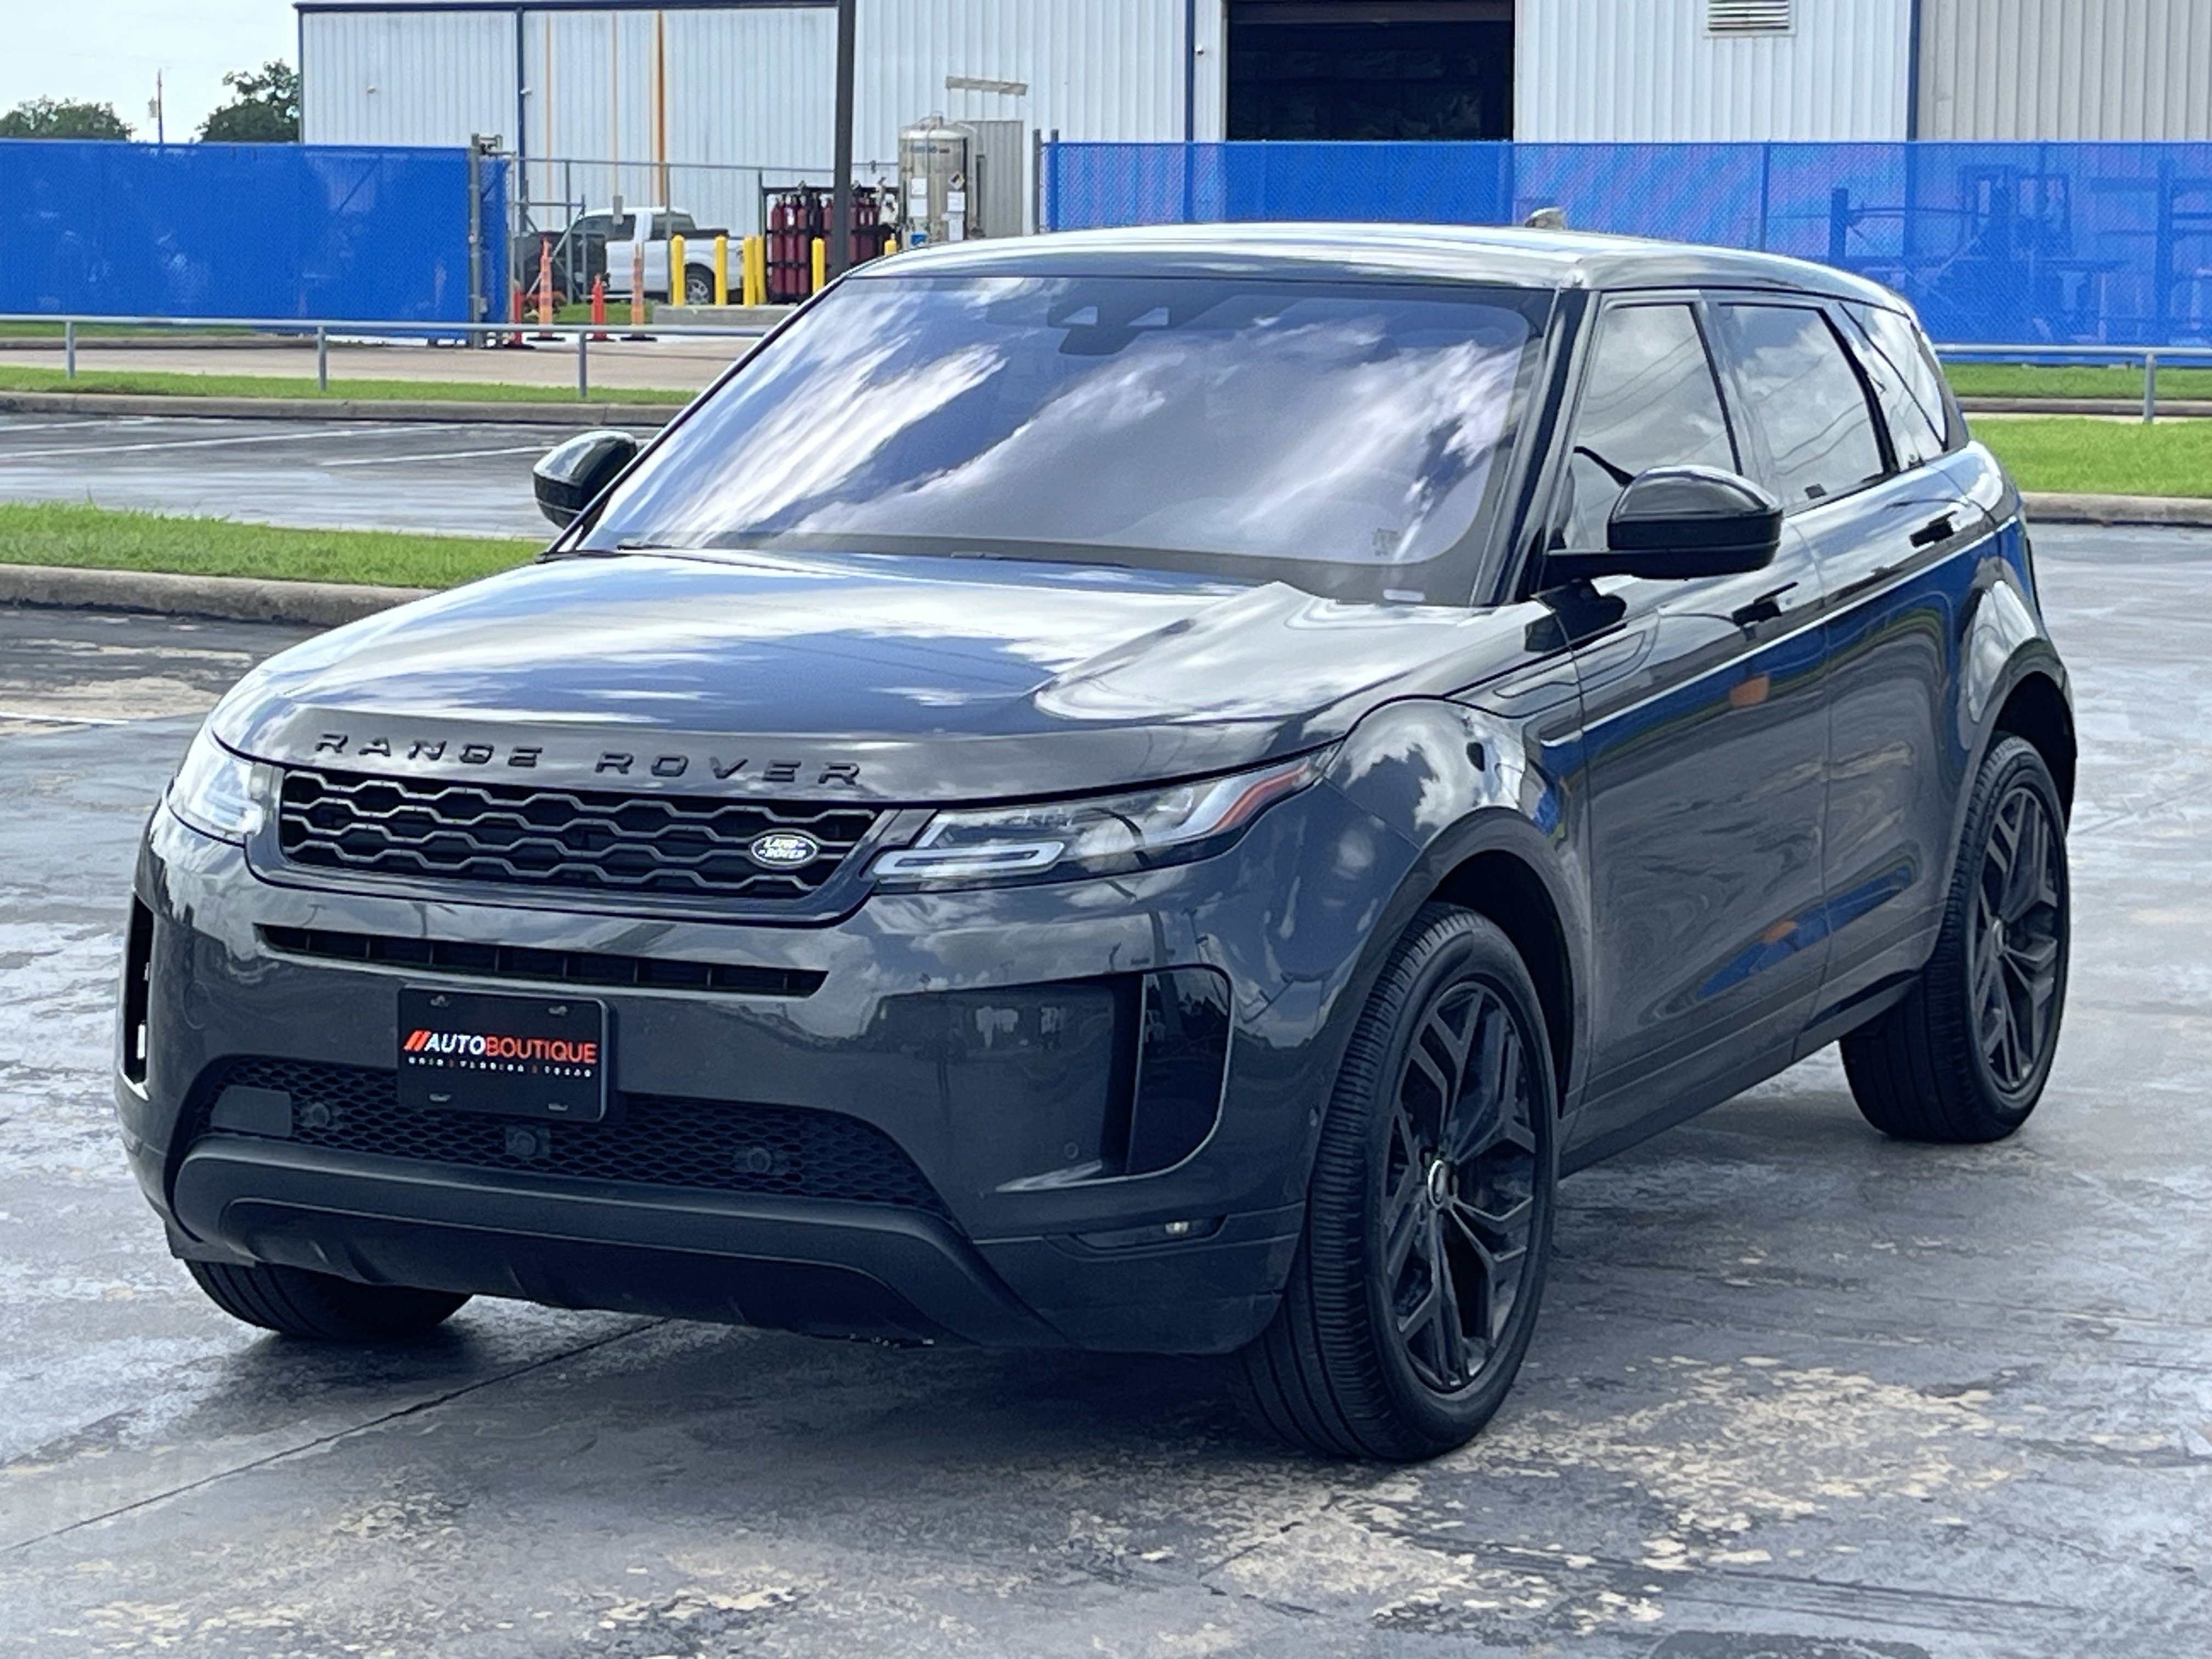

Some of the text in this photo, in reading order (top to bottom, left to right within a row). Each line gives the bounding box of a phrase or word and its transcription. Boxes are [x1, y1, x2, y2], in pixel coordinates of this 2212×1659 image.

[315, 733, 860, 785] RANGE ROVER
[424, 1033, 597, 1064] AUTOBOUTIQUE
